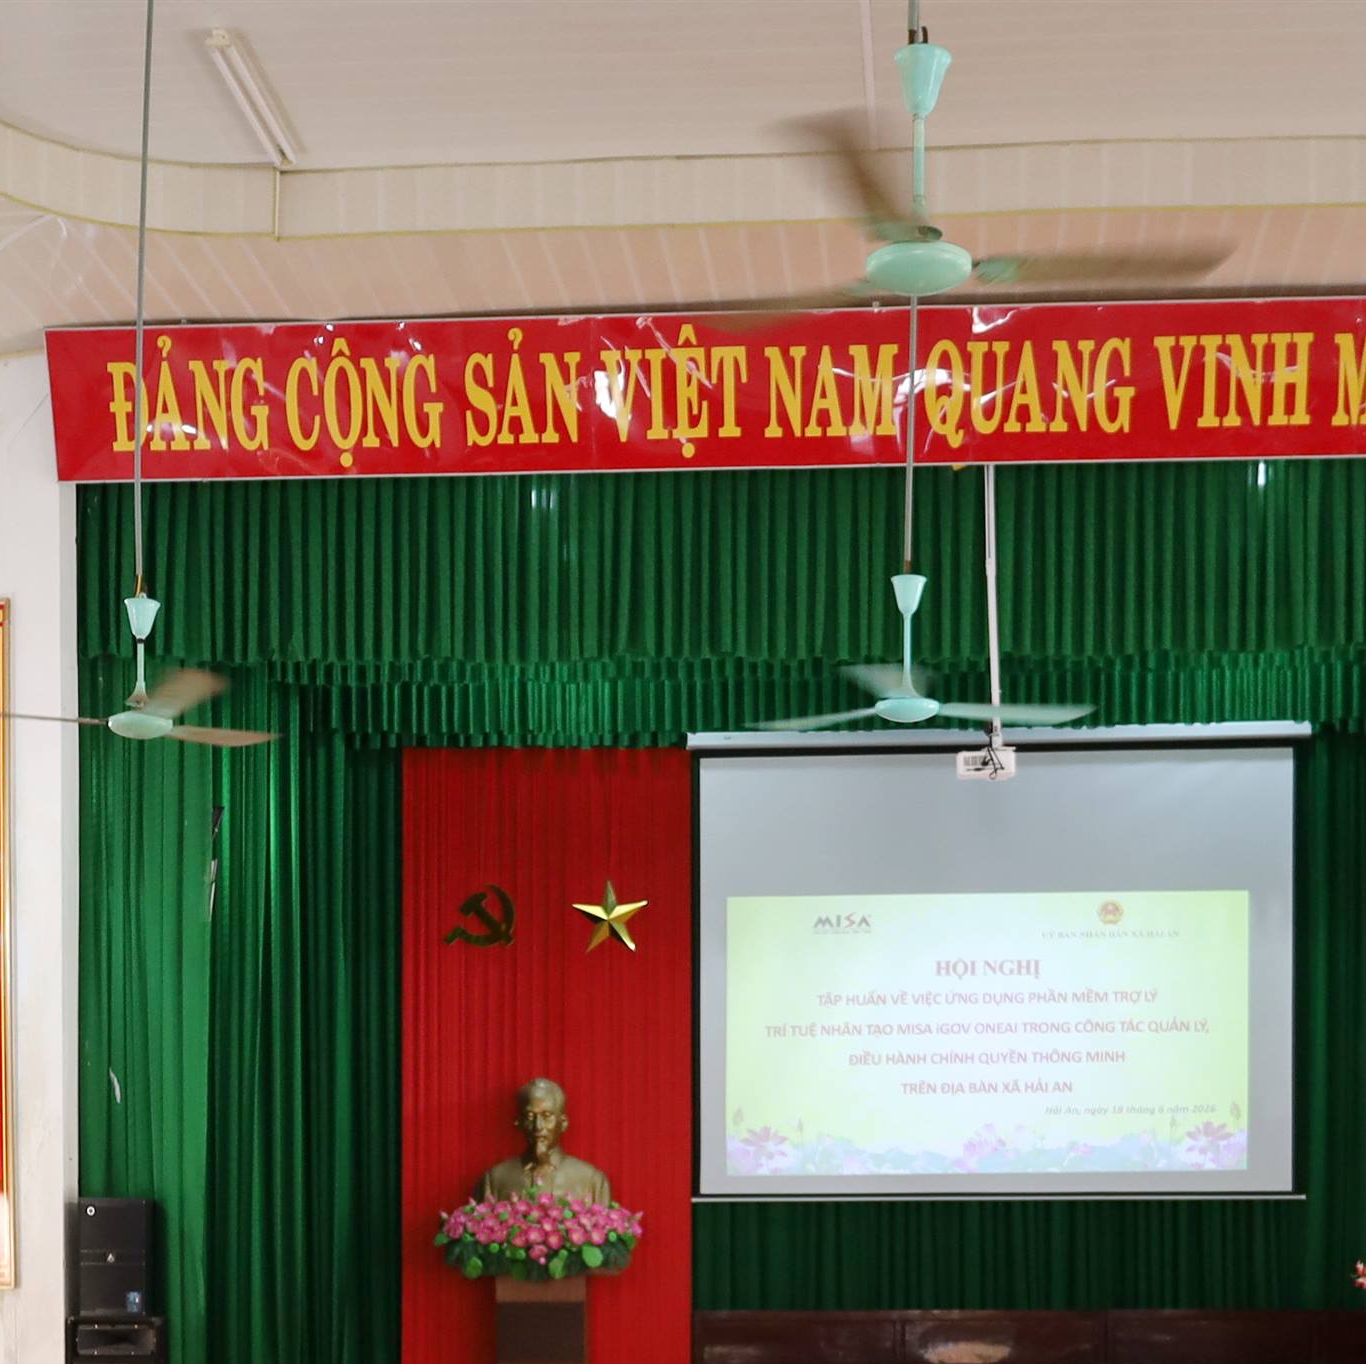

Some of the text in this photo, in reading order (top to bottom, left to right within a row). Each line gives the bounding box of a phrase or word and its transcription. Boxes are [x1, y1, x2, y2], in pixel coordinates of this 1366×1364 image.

[106, 334, 266, 455] ĐẢNG
[285, 336, 445, 468] CỘNG
[464, 327, 583, 448] SẢN
[601, 323, 748, 460] VIỆT
[762, 343, 900, 438] NAM
[924, 336, 1138, 449] QUANG
[1153, 331, 1315, 428] VINH
[812, 912, 872, 928] MISA
[935, 958, 1042, 980] HỘI NGHỊ
